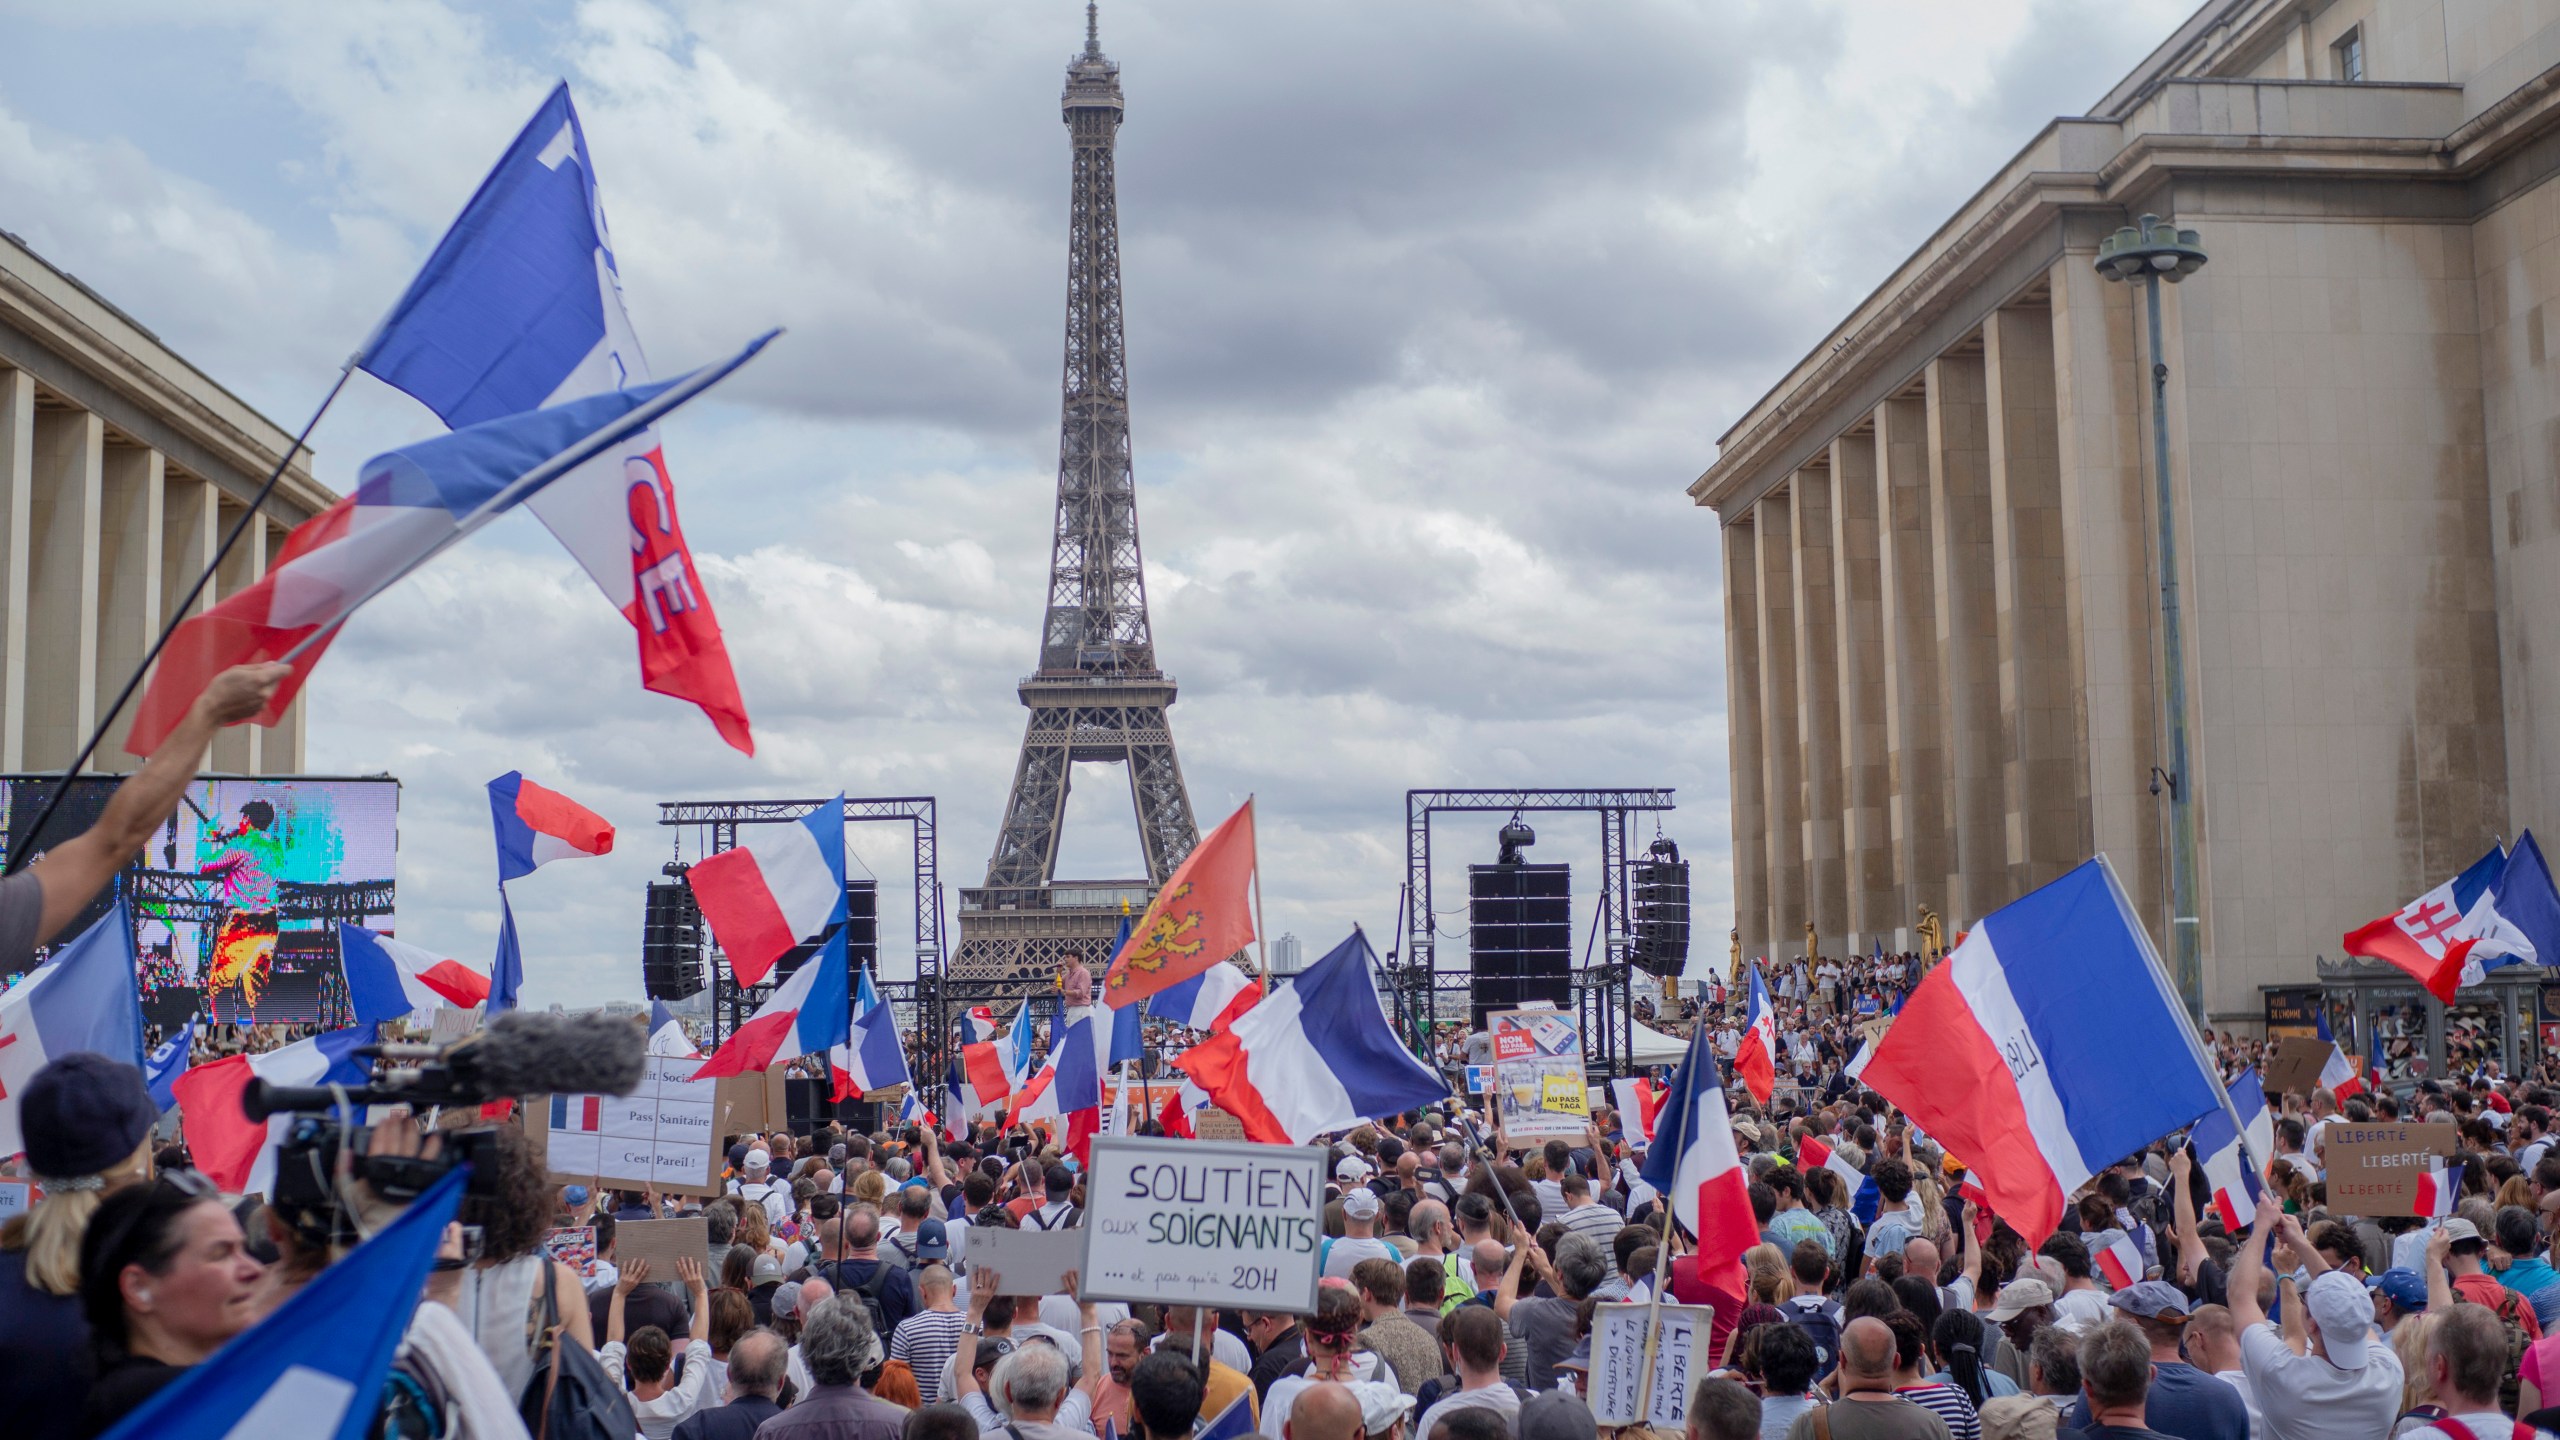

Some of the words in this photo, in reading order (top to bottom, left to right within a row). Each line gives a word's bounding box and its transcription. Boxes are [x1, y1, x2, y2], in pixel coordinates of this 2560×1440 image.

[1499, 1035, 1523, 1044] NON
[1474, 1076, 1496, 1084] LIBERT
[1548, 1083, 1579, 1097] OUI
[629, 1111, 653, 1122] Pass
[659, 1114, 710, 1127] Sanitaire
[2336, 1127, 2407, 1144] LIBERTÉ
[624, 1152, 651, 1164] C'est
[656, 1155, 688, 1167] Pareil
[2362, 1146, 2431, 1168] LIBERTÉ
[2338, 1180, 2403, 1195] LIBERTÉ
[1101, 1218, 1139, 1235] aux
[1155, 1272, 1181, 1292] pas
[1230, 1265, 1278, 1292] 20H
